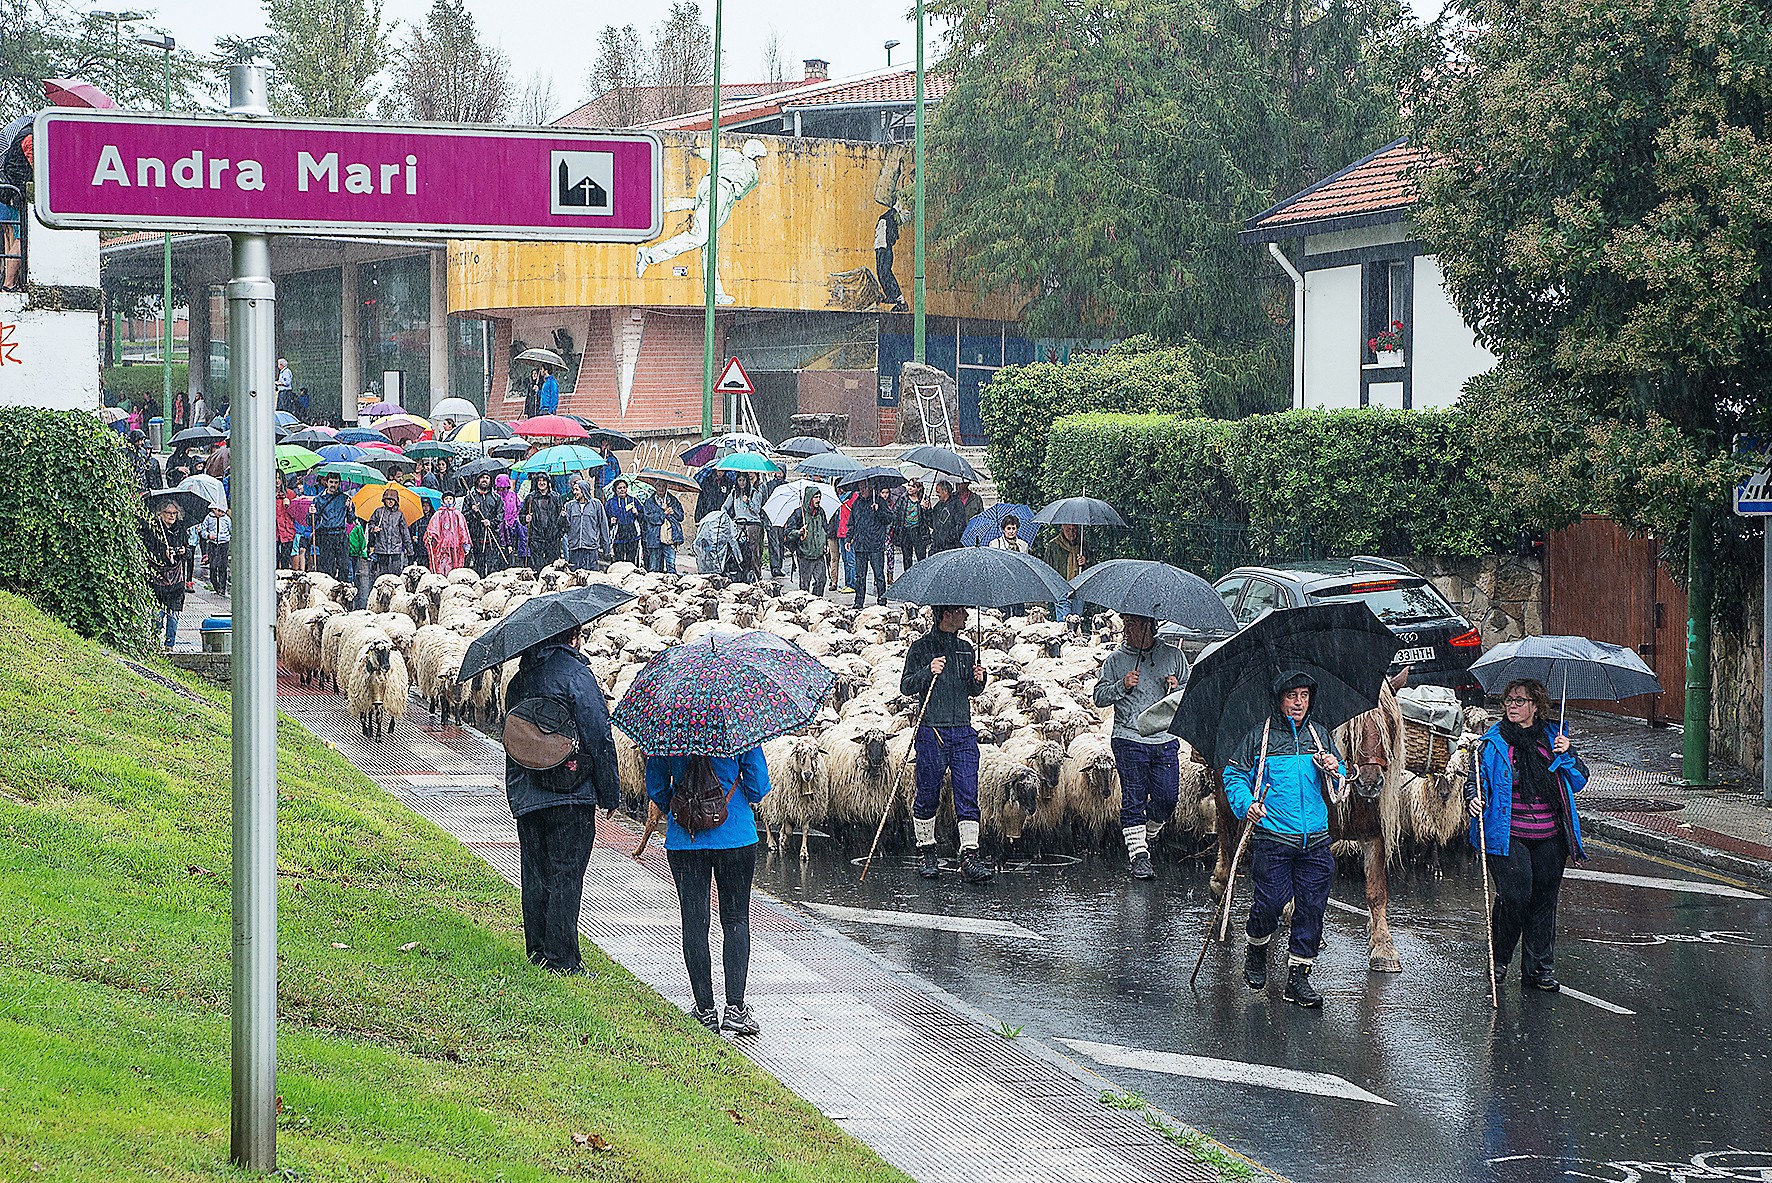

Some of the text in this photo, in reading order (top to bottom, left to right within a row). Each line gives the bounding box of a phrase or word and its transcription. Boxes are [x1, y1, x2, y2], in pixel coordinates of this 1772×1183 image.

[91, 144, 418, 196] Andra Mari
[1412, 647, 1433, 660] HTH
